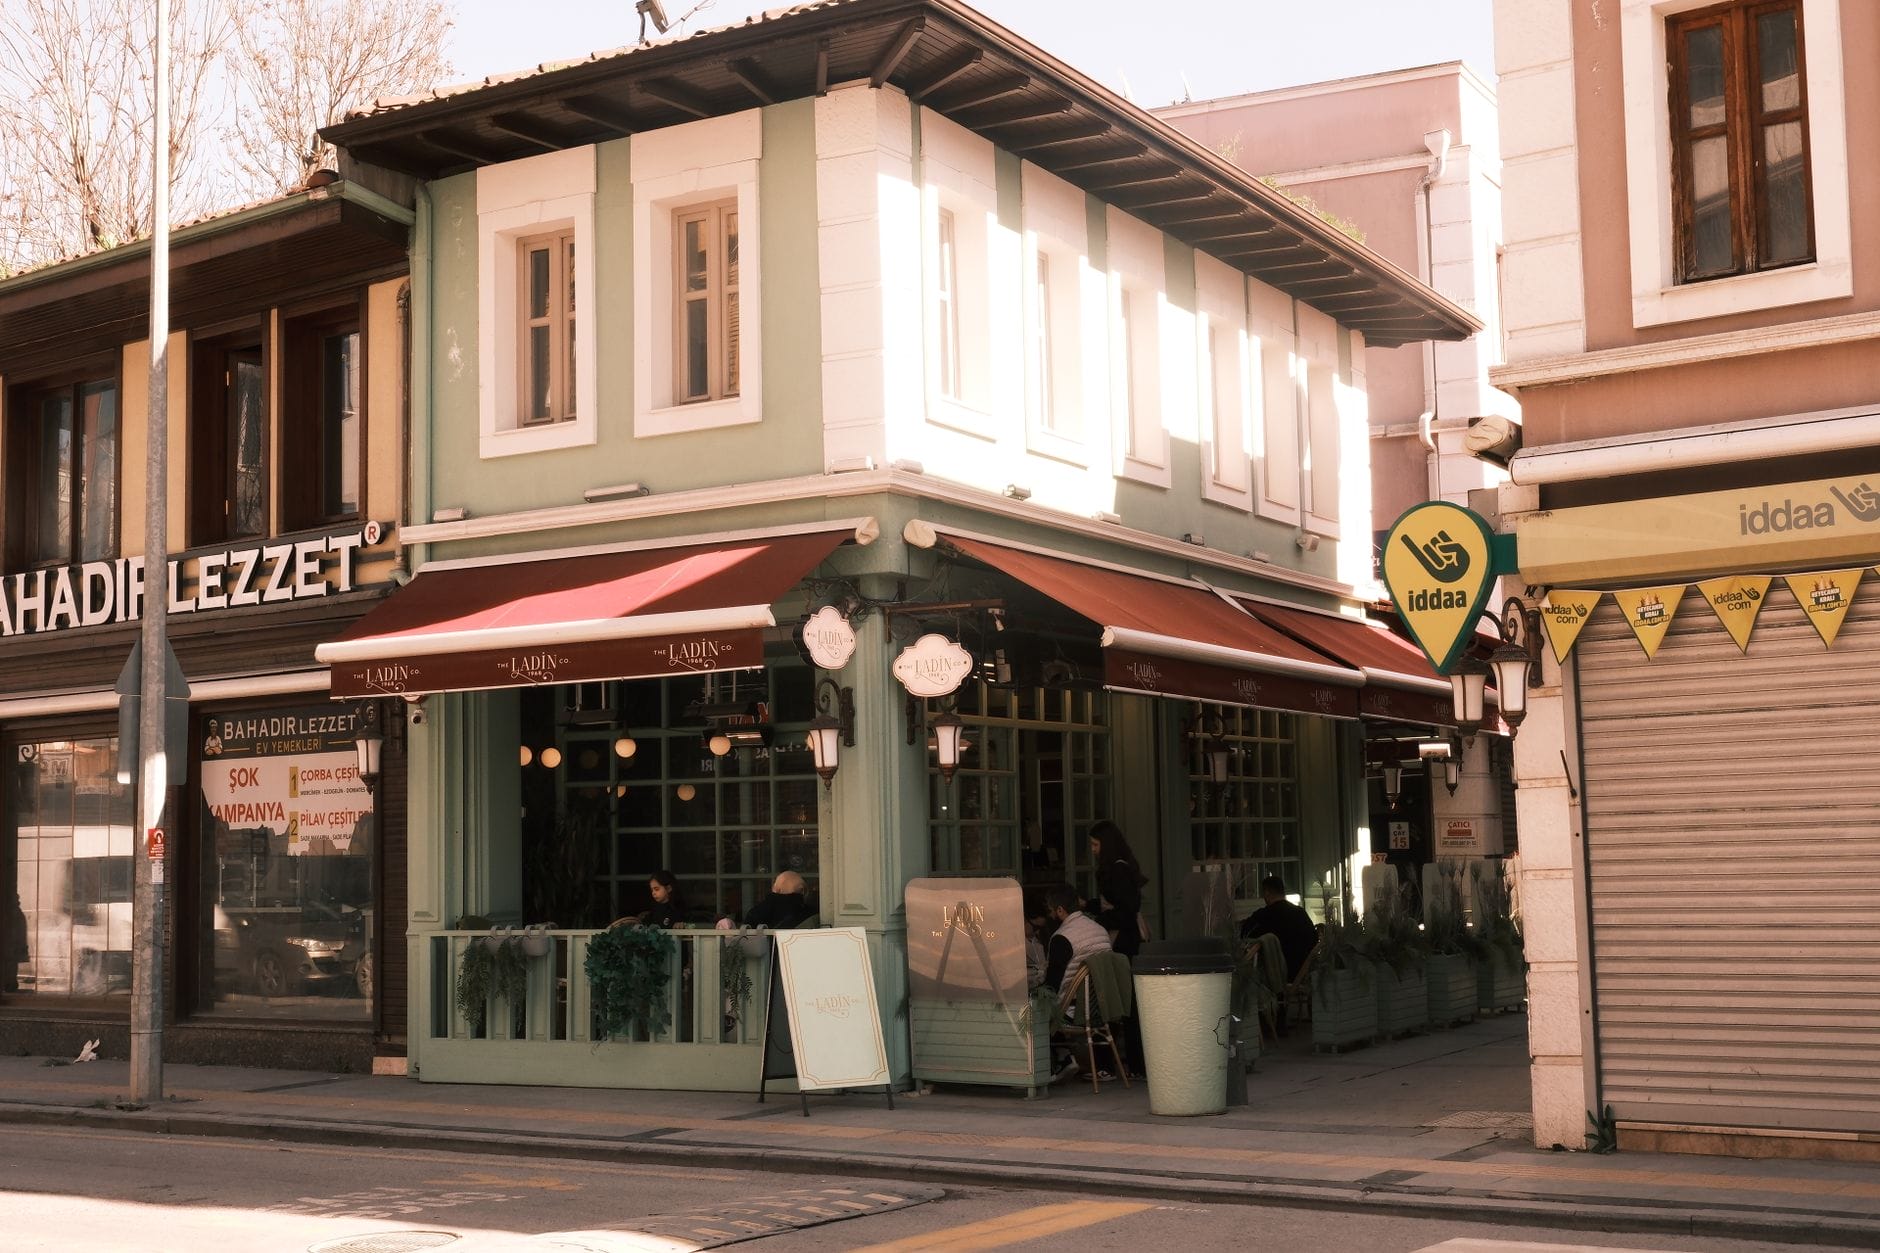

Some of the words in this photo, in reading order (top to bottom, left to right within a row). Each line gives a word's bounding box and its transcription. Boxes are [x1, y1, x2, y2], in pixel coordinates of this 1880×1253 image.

[1739, 499, 1835, 536] iddaa
[167, 531, 362, 614] LEZZET
[1408, 588, 1468, 612] iddaa
[1713, 592, 1743, 605] iddaa
[1727, 601, 1752, 611] com
[1545, 604, 1571, 615] iddaa
[1556, 615, 1578, 624] com
[669, 638, 719, 659] LADİN
[511, 651, 558, 671] LADİN
[915, 655, 952, 673] LADİN
[1133, 661, 1157, 679] LADİN
[366, 663, 408, 683] LADİN
[224, 717, 296, 741] BAHADIR
[300, 714, 357, 735] LEZZET
[256, 742, 270, 754] EV
[272, 737, 323, 753] YEMEKLERİ
[229, 767, 260, 793] ŞOK
[300, 769, 333, 784] ÇORBA
[290, 818, 298, 836] 2
[300, 809, 325, 827] PİLAV
[1392, 836, 1407, 848] 15
